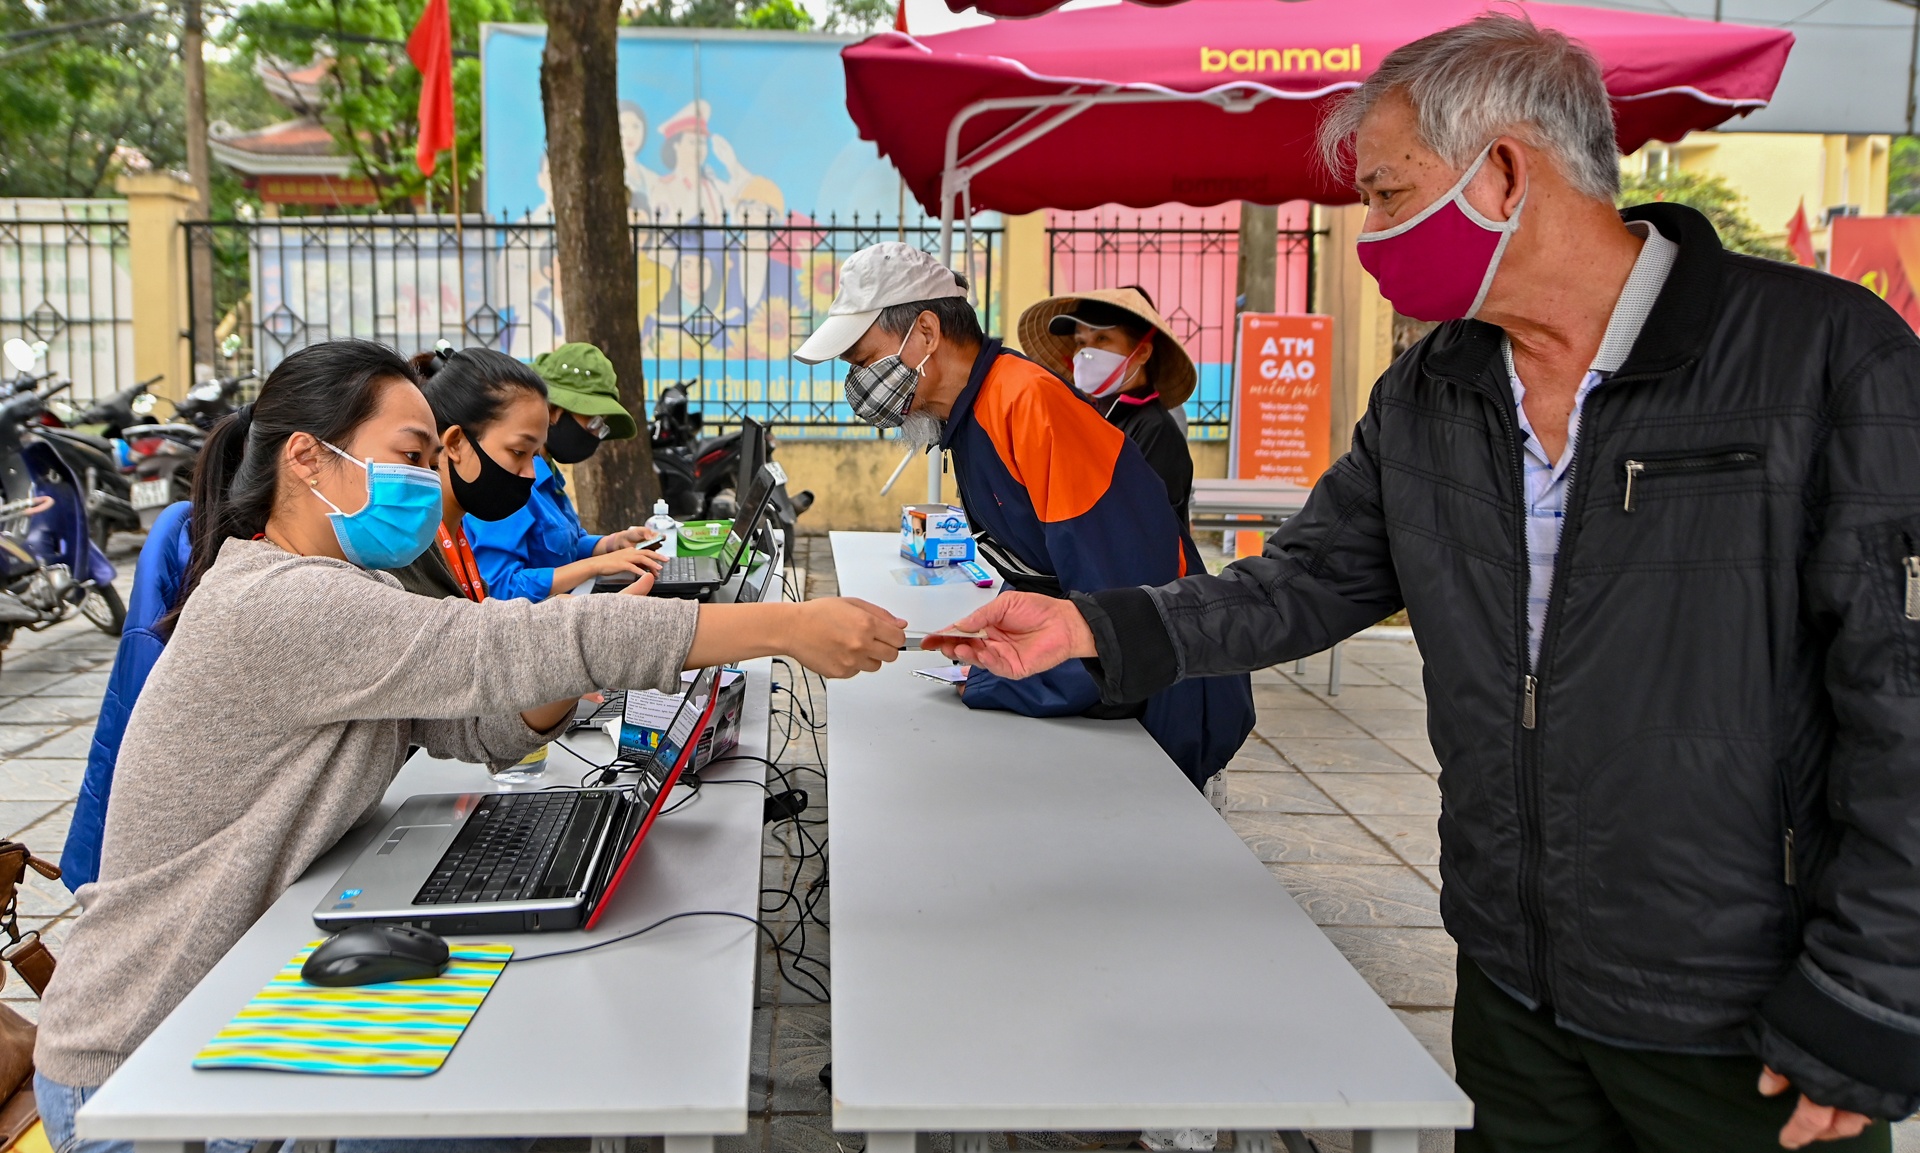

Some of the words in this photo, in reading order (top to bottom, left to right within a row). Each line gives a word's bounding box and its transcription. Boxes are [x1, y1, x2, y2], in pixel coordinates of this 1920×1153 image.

[1200, 43, 1362, 72] banmai
[1260, 336, 1315, 358] ATM
[1260, 359, 1316, 384] GẠO
[1291, 380, 1321, 400] phí
